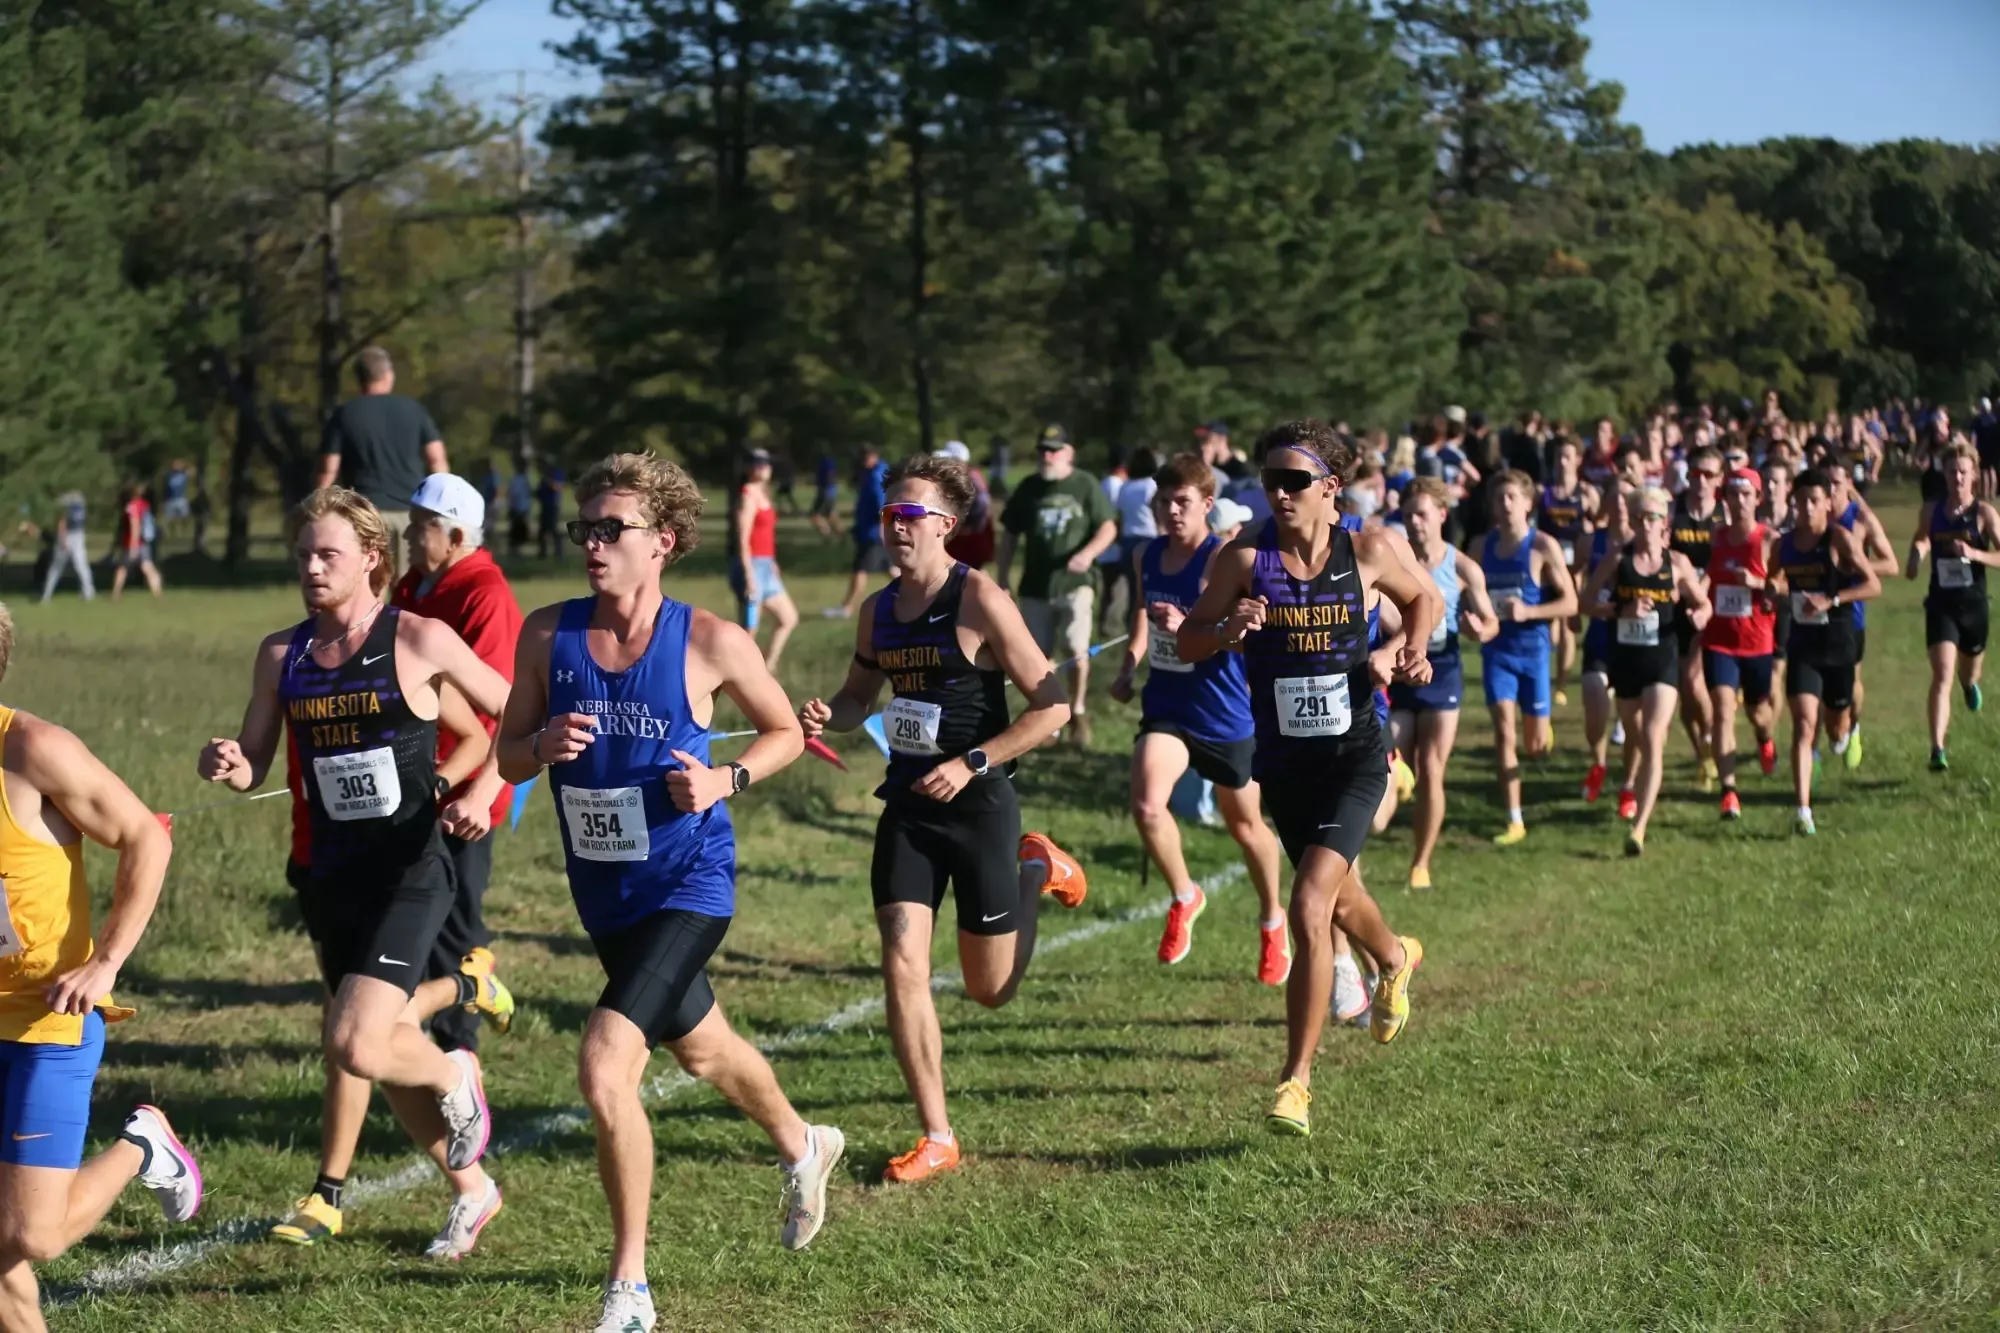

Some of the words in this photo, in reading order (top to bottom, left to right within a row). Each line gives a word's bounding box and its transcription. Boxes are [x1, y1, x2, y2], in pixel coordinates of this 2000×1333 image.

[1267, 604, 1350, 628] MINNESOTA
[1287, 631, 1332, 652] STATE
[290, 692, 380, 719] MINNESOTA
[574, 700, 651, 717] NEBRASKA
[1294, 696, 1330, 717] 291
[895, 716, 921, 741] 298
[1287, 719, 1301, 728] RIM
[1301, 718, 1321, 728] ROCK
[1321, 717, 1341, 727] FARM
[313, 723, 360, 747] STATE
[337, 773, 377, 799] 303
[348, 800, 369, 811] ROCK
[368, 797, 390, 809] FARM
[580, 799, 625, 809] PRE-NATIONALS
[581, 812, 623, 838] 354
[579, 838, 590, 850] RIM
[591, 840, 613, 852] ROCK
[612, 840, 637, 851] FARM
